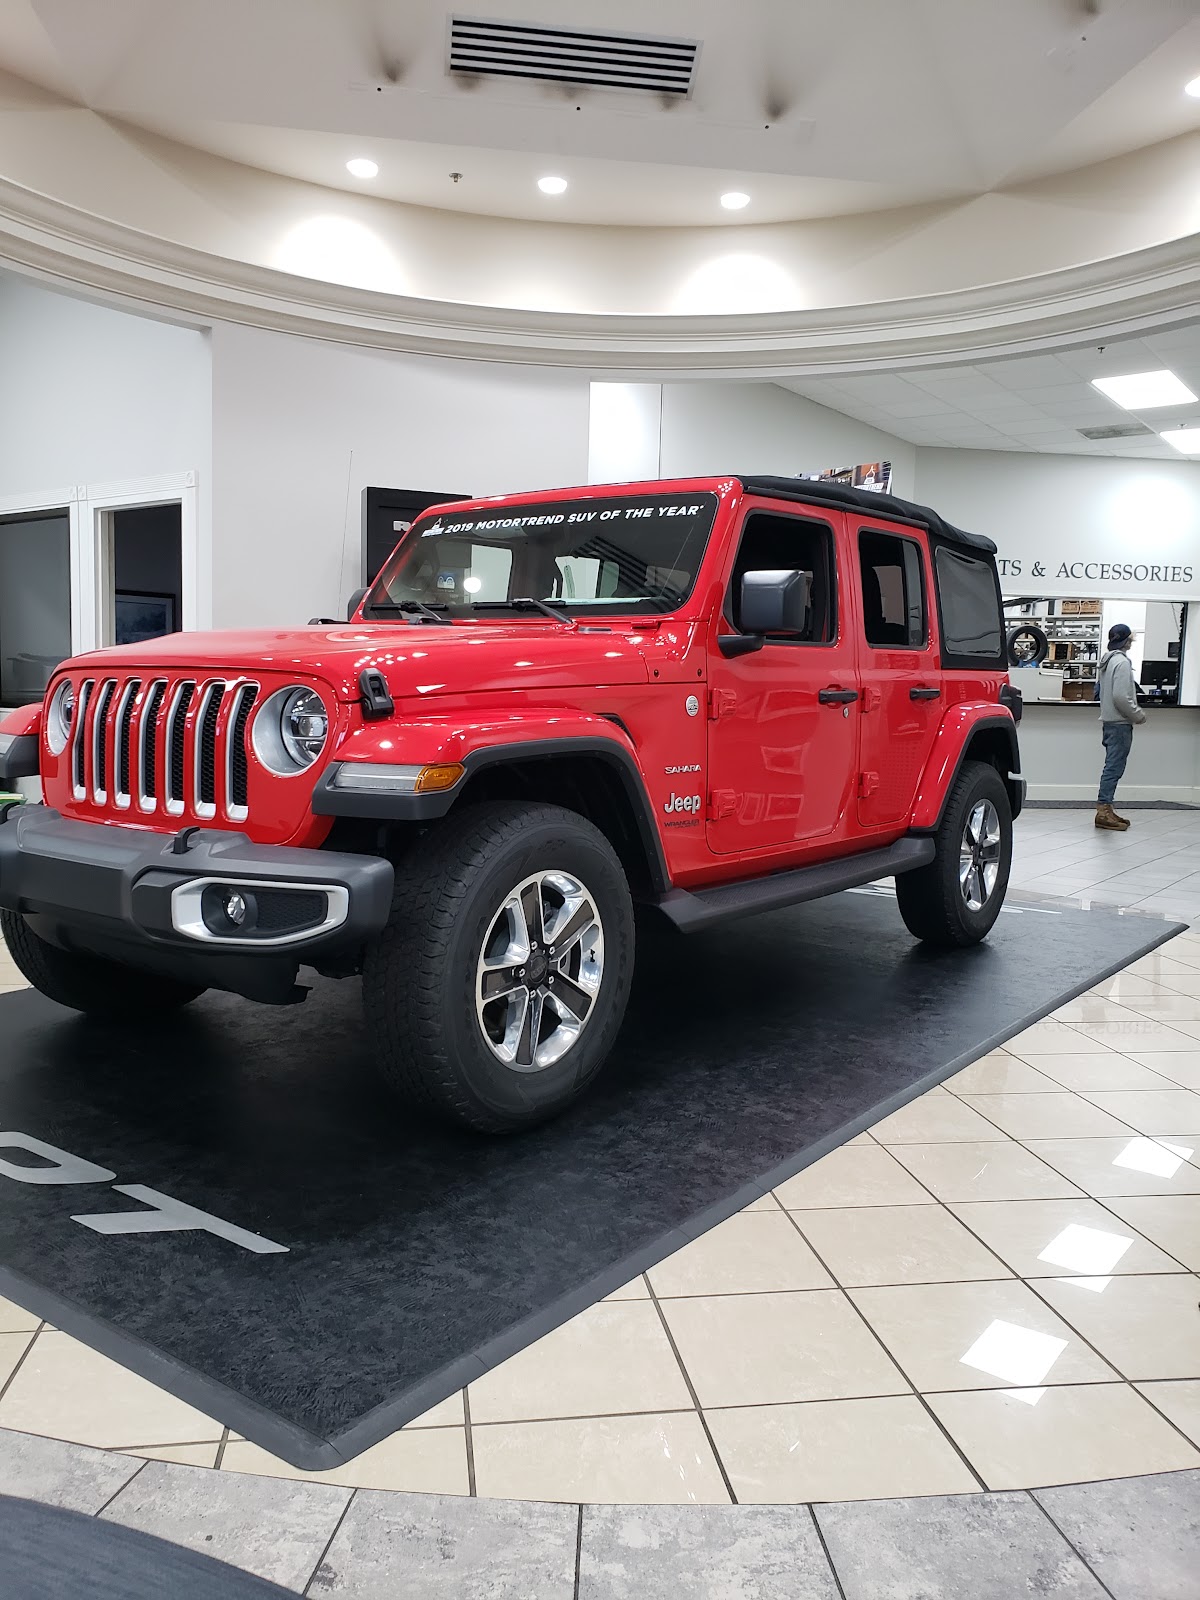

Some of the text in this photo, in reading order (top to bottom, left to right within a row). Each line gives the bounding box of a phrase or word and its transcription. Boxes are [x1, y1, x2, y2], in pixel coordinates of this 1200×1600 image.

[445, 523, 474, 534] 2019
[475, 515, 565, 531] MOTORTREND
[567, 512, 597, 523] SUV
[599, 510, 622, 521] OF
[624, 507, 655, 519] THE
[1031, 561, 1047, 577] &
[1056, 562, 1193, 583] ACCESSORIES
[664, 764, 702, 775] SAHARA
[664, 792, 702, 815] Jeep
